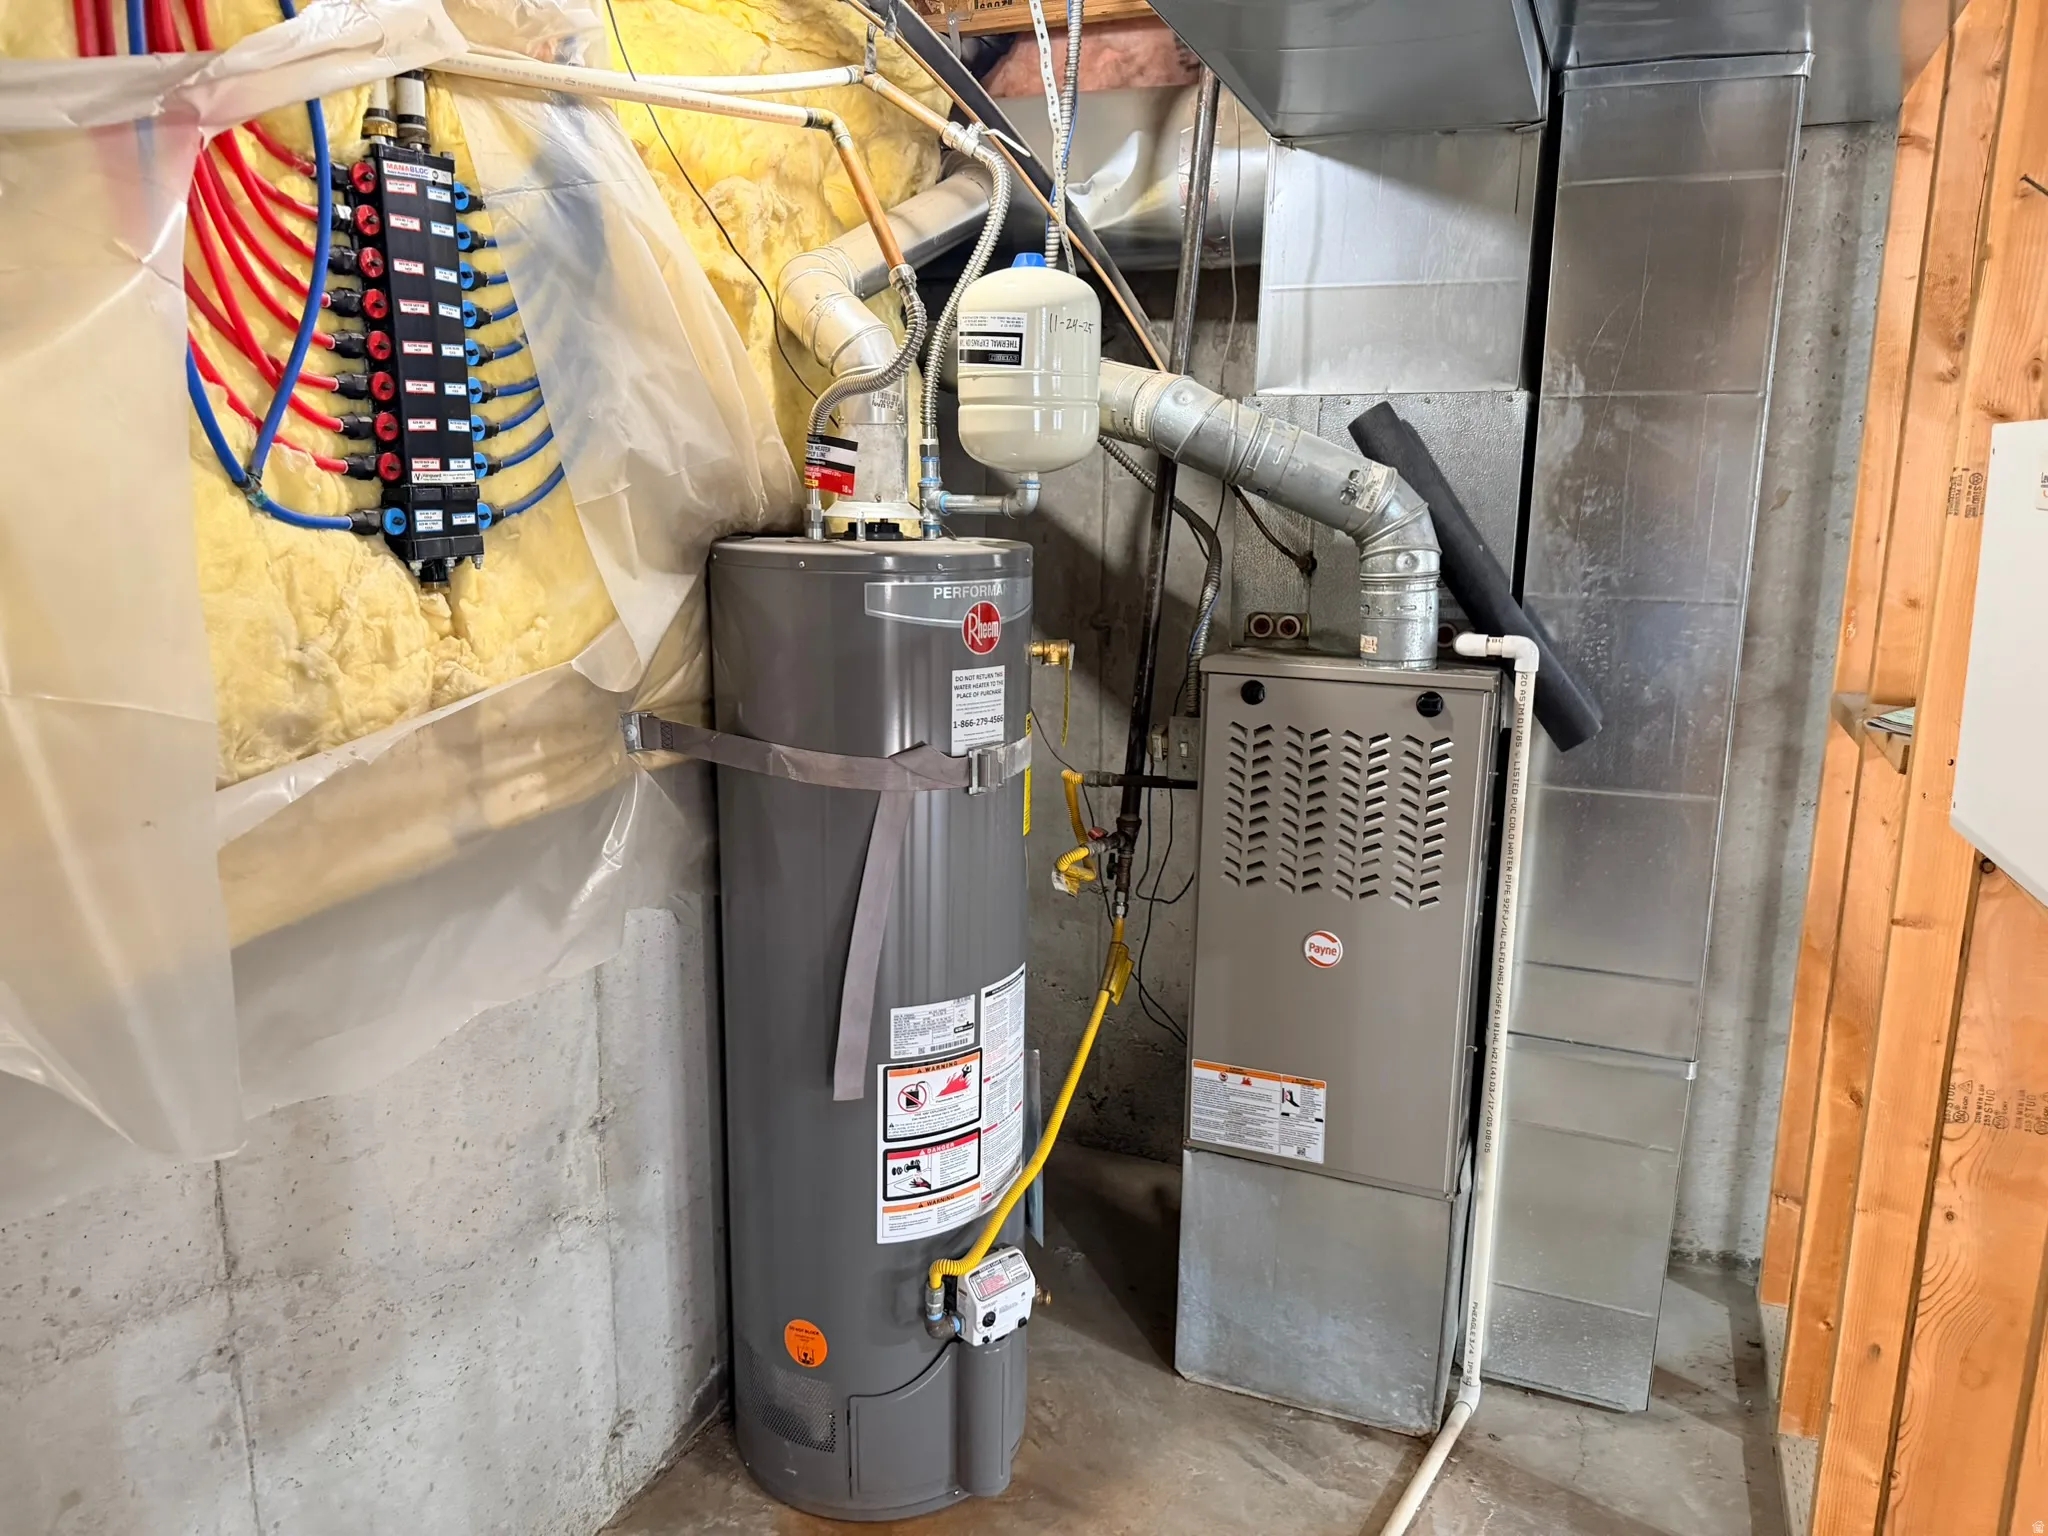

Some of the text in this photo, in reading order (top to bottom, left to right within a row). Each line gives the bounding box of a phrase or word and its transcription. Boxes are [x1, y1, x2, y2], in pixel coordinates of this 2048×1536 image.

[386, 162, 429, 175] MANABLOC
[1049, 313, 1094, 333] 11-24-25
[991, 339, 1018, 349] THERMAL
[967, 603, 999, 647] Rheem
[976, 672, 994, 680] RETURN
[954, 683, 972, 691] WATER
[972, 681, 990, 689] HEATER
[1517, 689, 1526, 716] ASTM
[953, 714, 1004, 729] 1-866-279-4566
[1509, 796, 1518, 815] PVC
[1505, 841, 1515, 872] WATER
[1503, 873, 1513, 897] PIPE
[1308, 942, 1338, 956] Payne
[924, 1061, 958, 1073] WARNING
[1984, 1089, 1996, 1113] STUD
[926, 1142, 955, 1154] DANGER
[925, 1193, 955, 1207] WARNING
[1466, 1360, 1474, 1375] IPS
